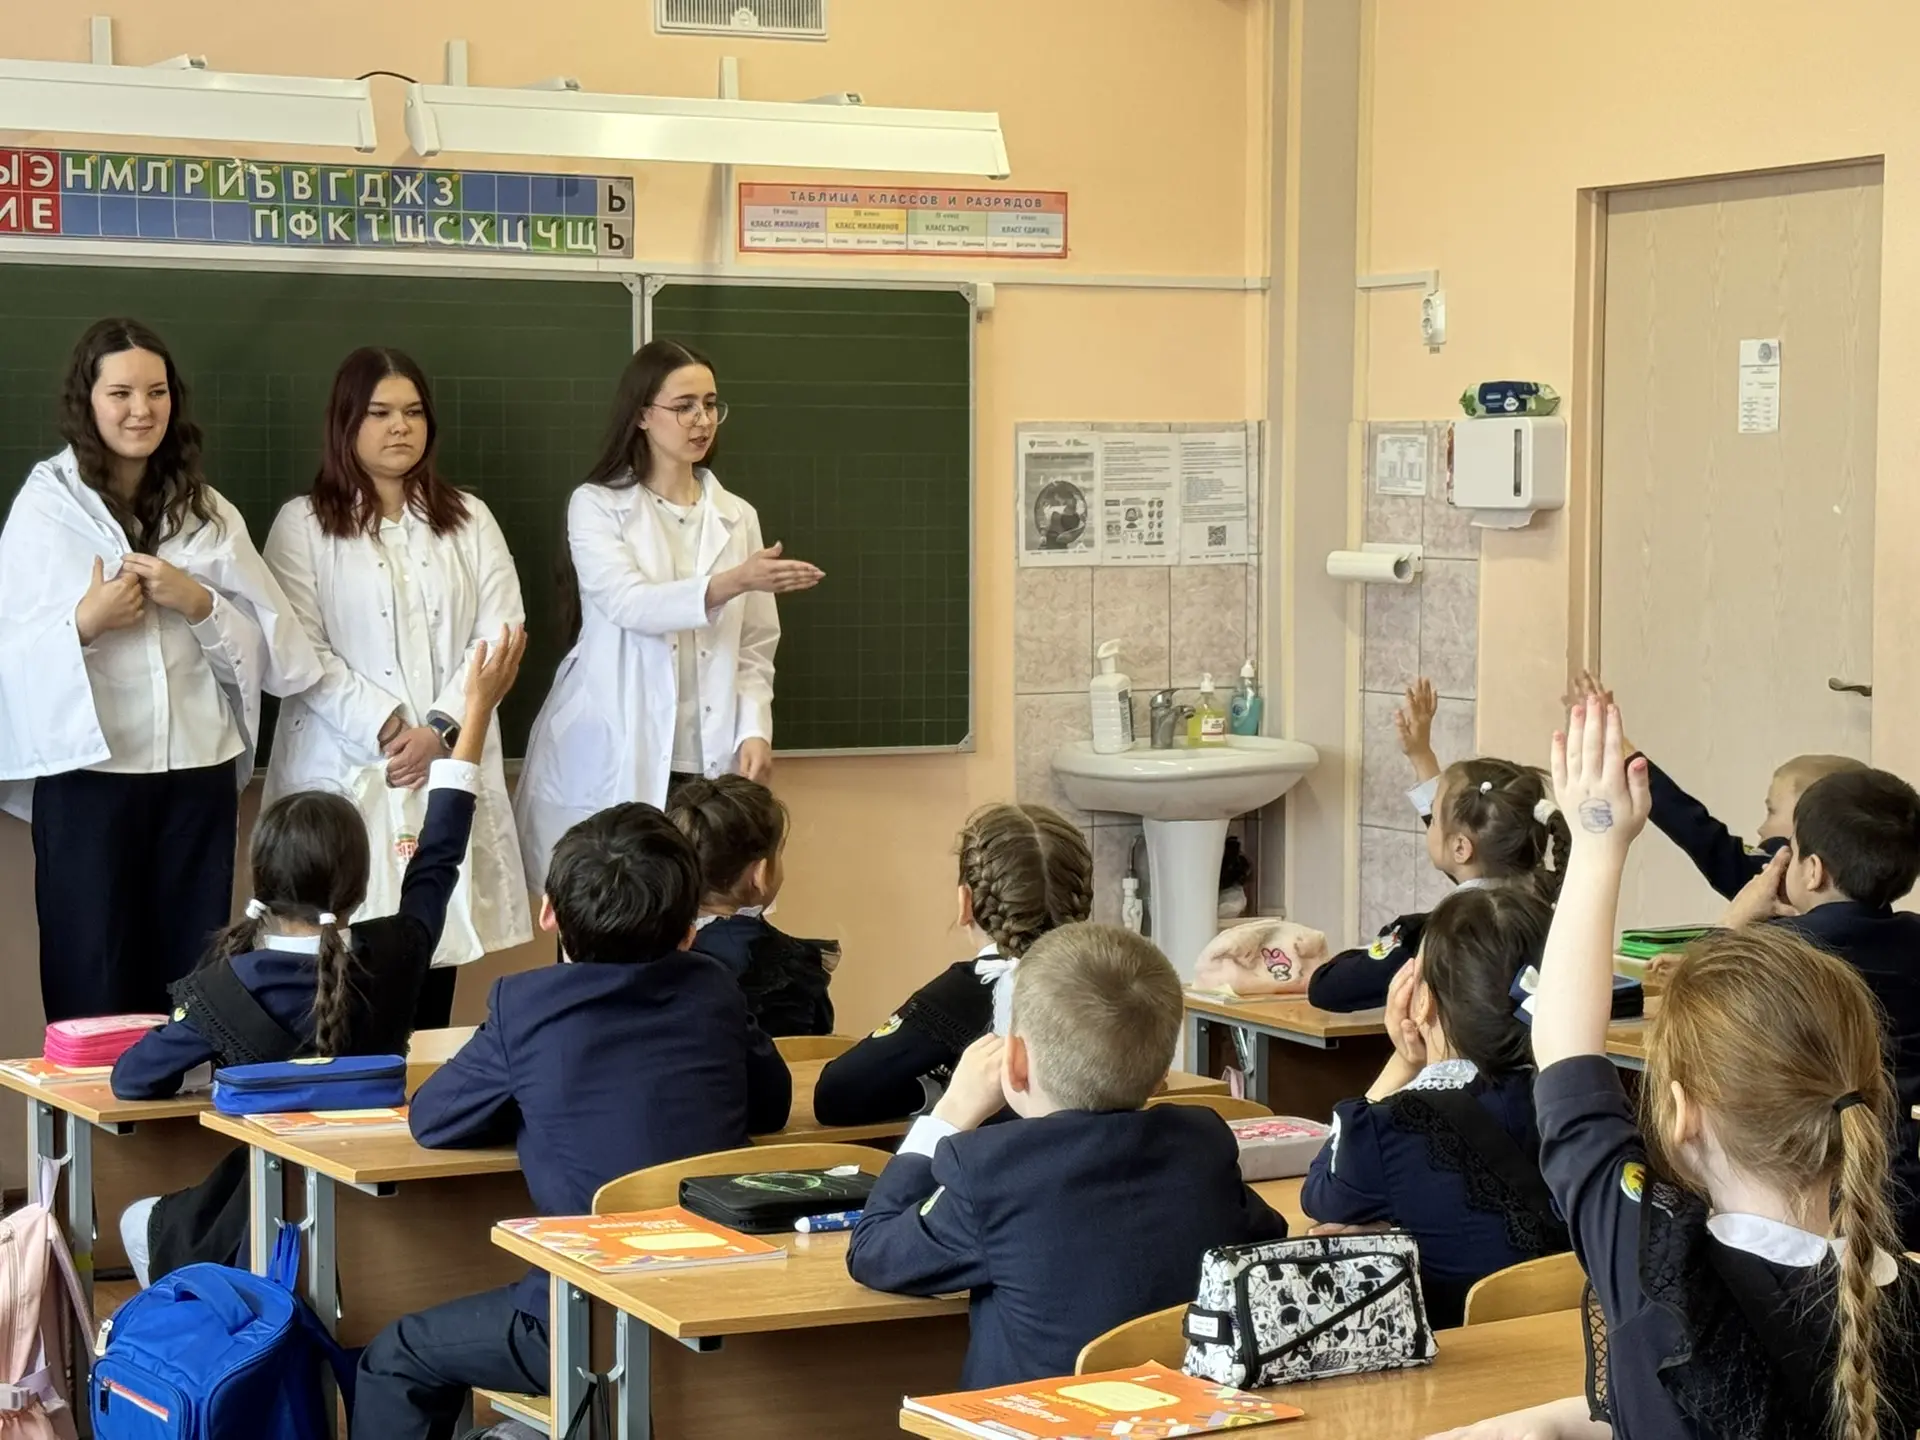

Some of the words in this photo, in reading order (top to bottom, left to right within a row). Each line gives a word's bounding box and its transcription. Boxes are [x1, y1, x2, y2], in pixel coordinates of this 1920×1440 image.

[29, 155, 54, 188] Э
[66, 157, 92, 190] Н
[101, 159, 135, 192] М
[141, 161, 168, 193] Л
[185, 164, 205, 195] Р
[254, 168, 277, 199] Б
[292, 170, 312, 200] В
[329, 172, 348, 201] Г
[359, 173, 386, 207] Д
[393, 174, 424, 206] Ж
[433, 177, 454, 206] З
[608, 185, 626, 213] Ь
[790, 191, 859, 204] ТАБЛИЦА
[868, 193, 938, 205] КЛАССОВ
[948, 196, 957, 206] И
[966, 196, 1042, 208] РАЗРЯДОВ
[32, 198, 54, 230] Е
[255, 209, 279, 239] П
[288, 210, 318, 240] Ф
[328, 212, 351, 241] К
[364, 213, 385, 242] Т
[394, 213, 426, 243] Ш
[433, 216, 456, 245] С
[468, 218, 492, 246] Х
[502, 218, 528, 250] Ц
[536, 220, 558, 249] Ч
[567, 222, 597, 253] Щ
[603, 224, 625, 251] Ъ
